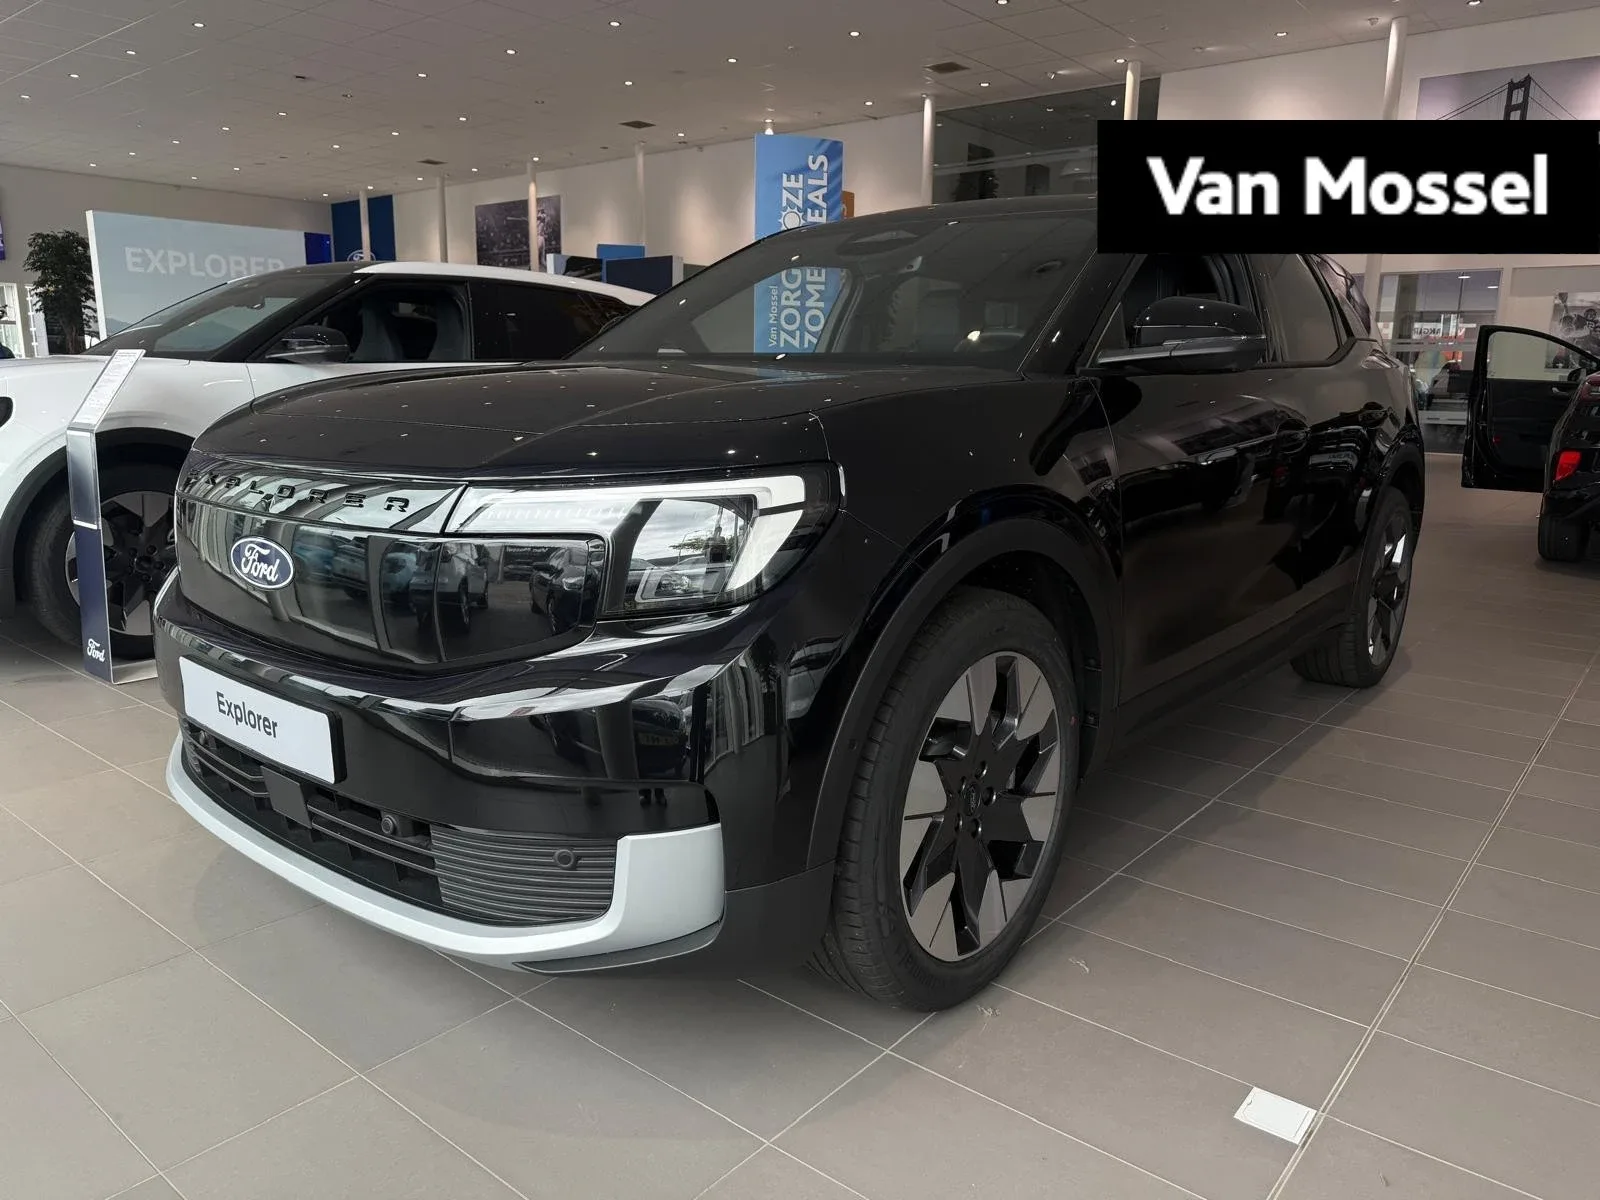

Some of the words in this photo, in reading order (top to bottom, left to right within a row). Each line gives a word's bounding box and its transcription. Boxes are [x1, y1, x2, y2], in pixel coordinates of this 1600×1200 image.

[768, 285, 779, 324] Mossel
[768, 327, 778, 348] Van
[184, 469, 410, 512] EXPLORER
[241, 543, 280, 582] Ford
[87, 638, 105, 662] Ford
[216, 691, 278, 738] Explorer
